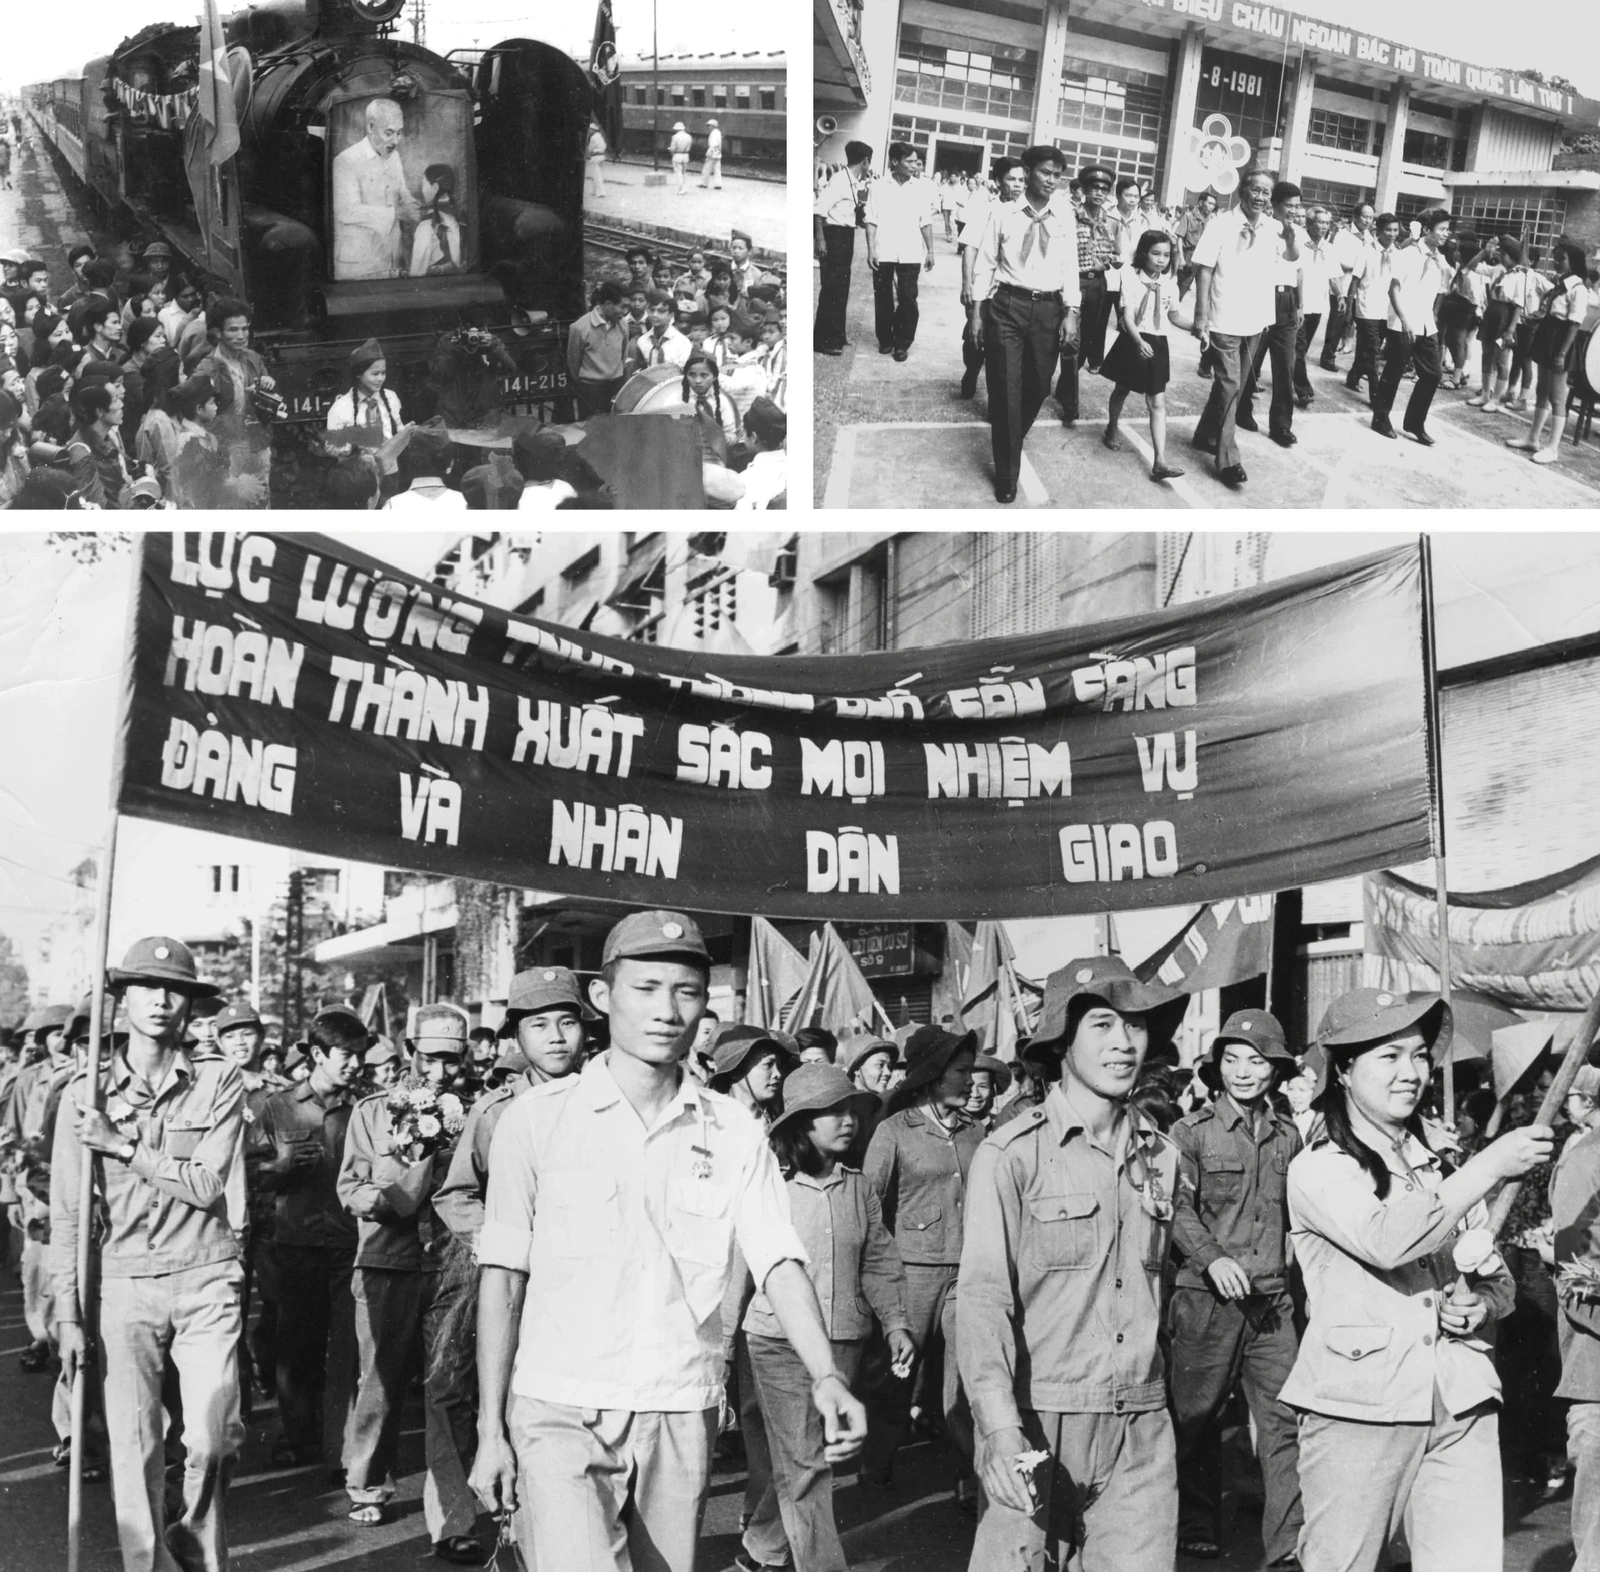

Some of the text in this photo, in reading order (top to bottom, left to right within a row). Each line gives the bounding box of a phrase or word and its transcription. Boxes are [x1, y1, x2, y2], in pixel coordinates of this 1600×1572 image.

[1232, 2, 1285, 38] CHÁU
[1293, 18, 1351, 55] NGOAN
[1357, 35, 1390, 64] BÁC
[294, 393, 343, 413] 141-
[504, 373, 567, 393] 141-215
[170, 532, 276, 603] LỰC
[296, 554, 484, 655] LƯỢNG
[947, 665, 1046, 719] SẴN
[1071, 645, 1197, 712] SÀNG
[163, 612, 1199, 808] HOÀN THÀNH XUẤT SẮC MỌI NHIỆM VỤ
[161, 711, 1179, 895] ĐẢNG VÀ NHÂN DÂN GIAO
